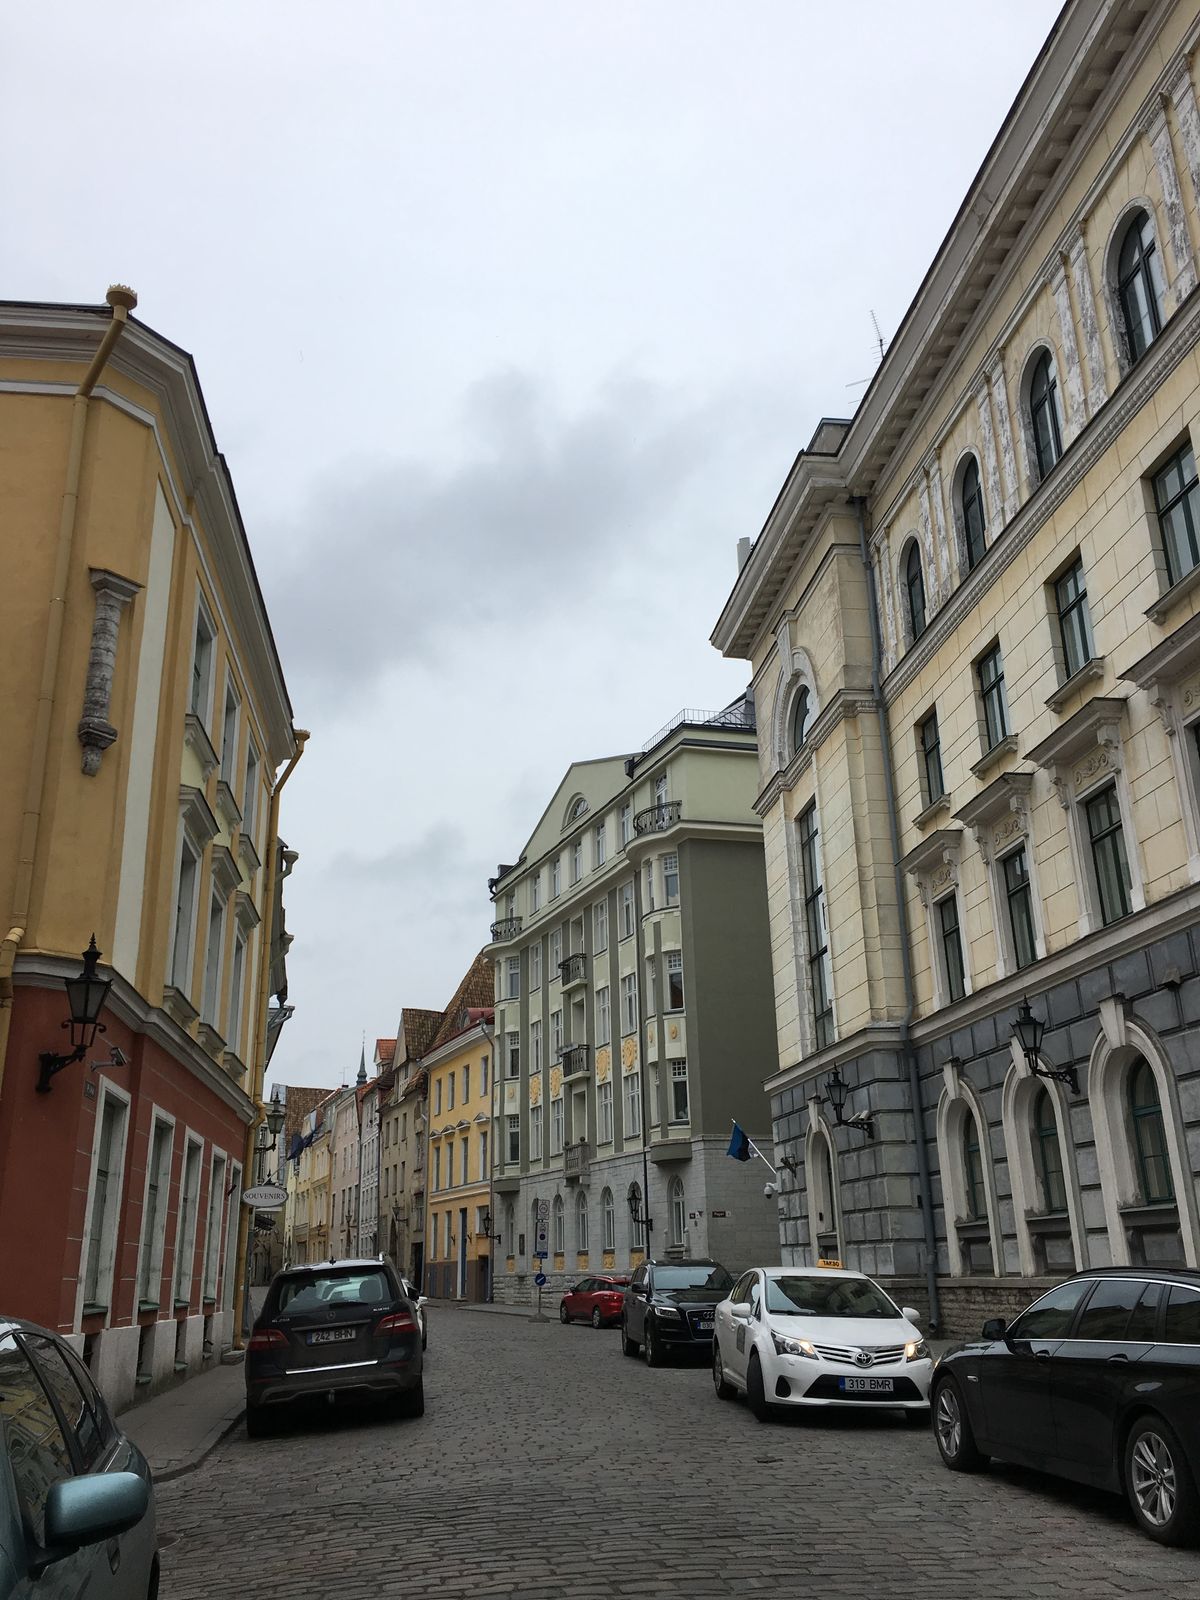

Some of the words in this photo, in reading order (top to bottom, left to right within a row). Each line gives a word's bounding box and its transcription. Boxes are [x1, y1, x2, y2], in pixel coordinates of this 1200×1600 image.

[315, 1331, 330, 1341] 242
[849, 1379, 865, 1389] 319
[870, 1379, 891, 1390] BMR
